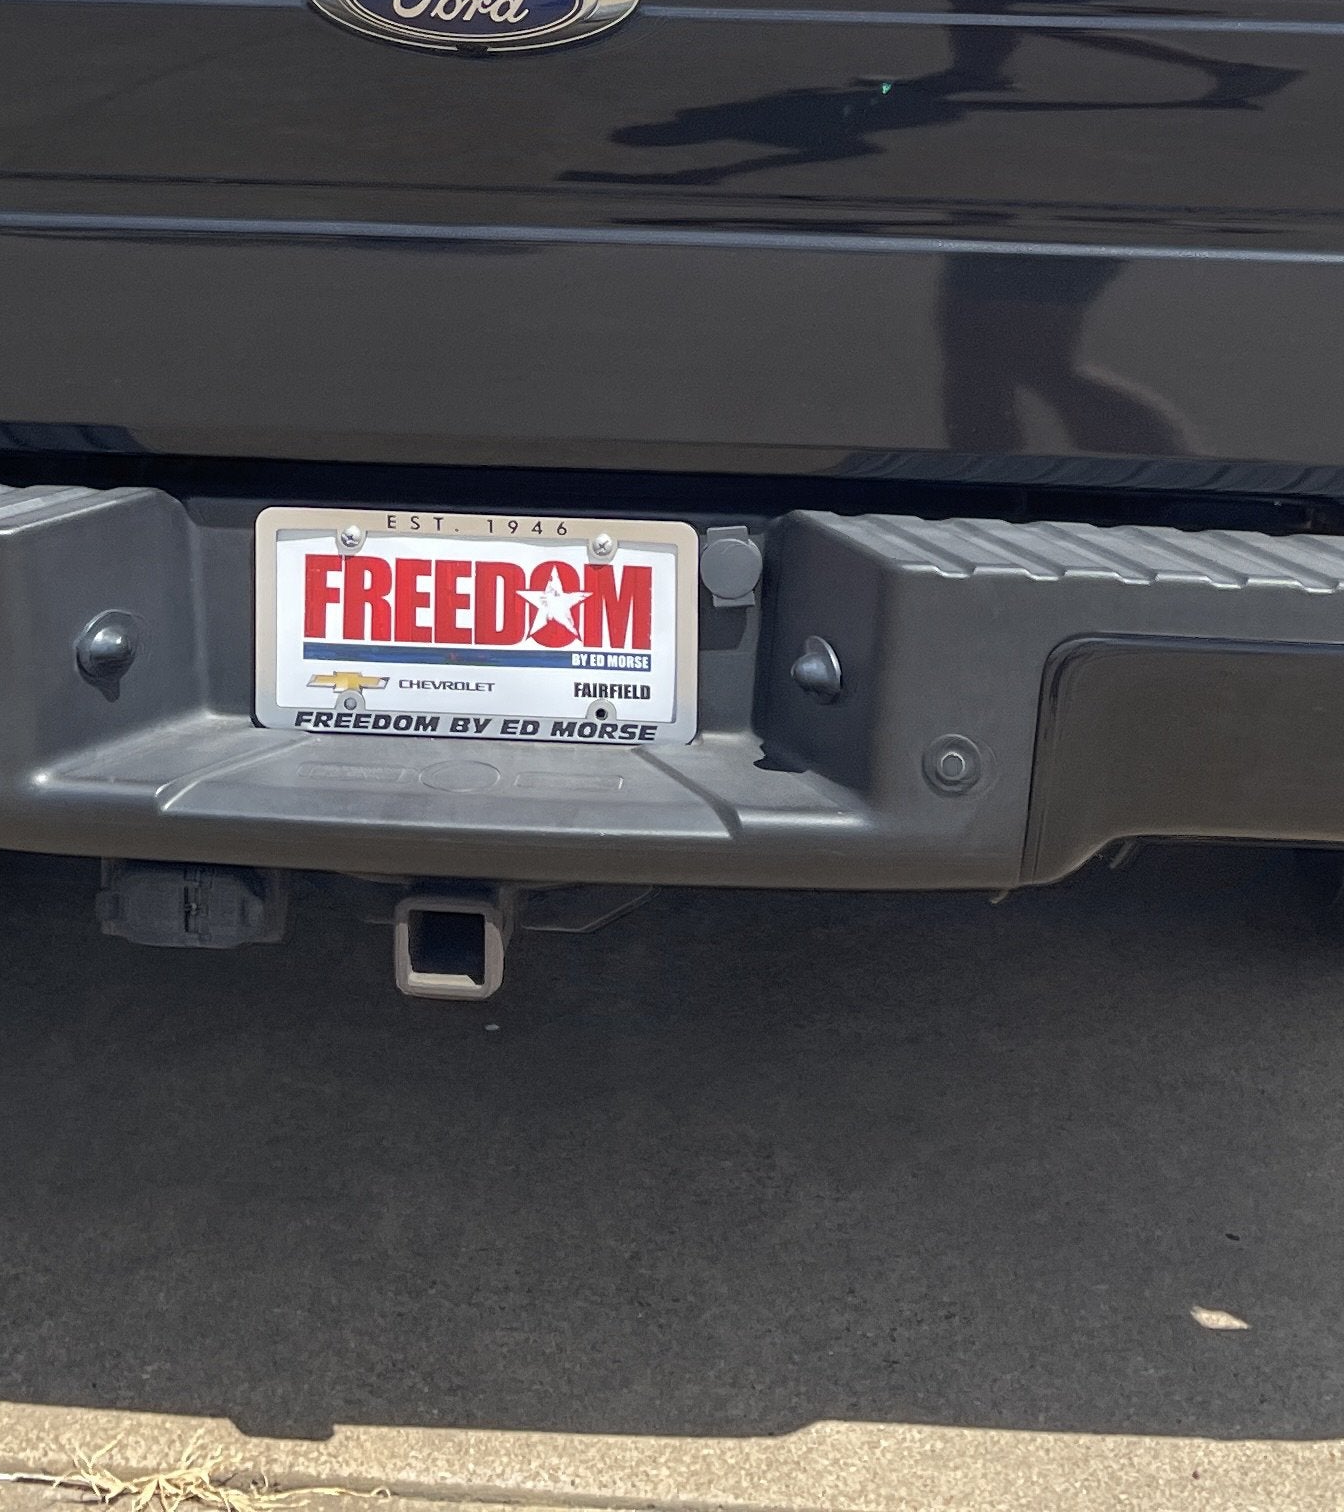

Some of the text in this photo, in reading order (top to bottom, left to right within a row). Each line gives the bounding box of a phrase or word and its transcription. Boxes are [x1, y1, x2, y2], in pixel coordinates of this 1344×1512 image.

[387, 515, 568, 536] EST. 1946
[303, 554, 652, 650] FREEDOM
[572, 653, 649, 669] BY ED MORSE
[399, 679, 495, 692] CHEVROLET
[574, 682, 651, 700] FAIRFIELD
[294, 711, 658, 741] FREEDOM BY ED MORSE
